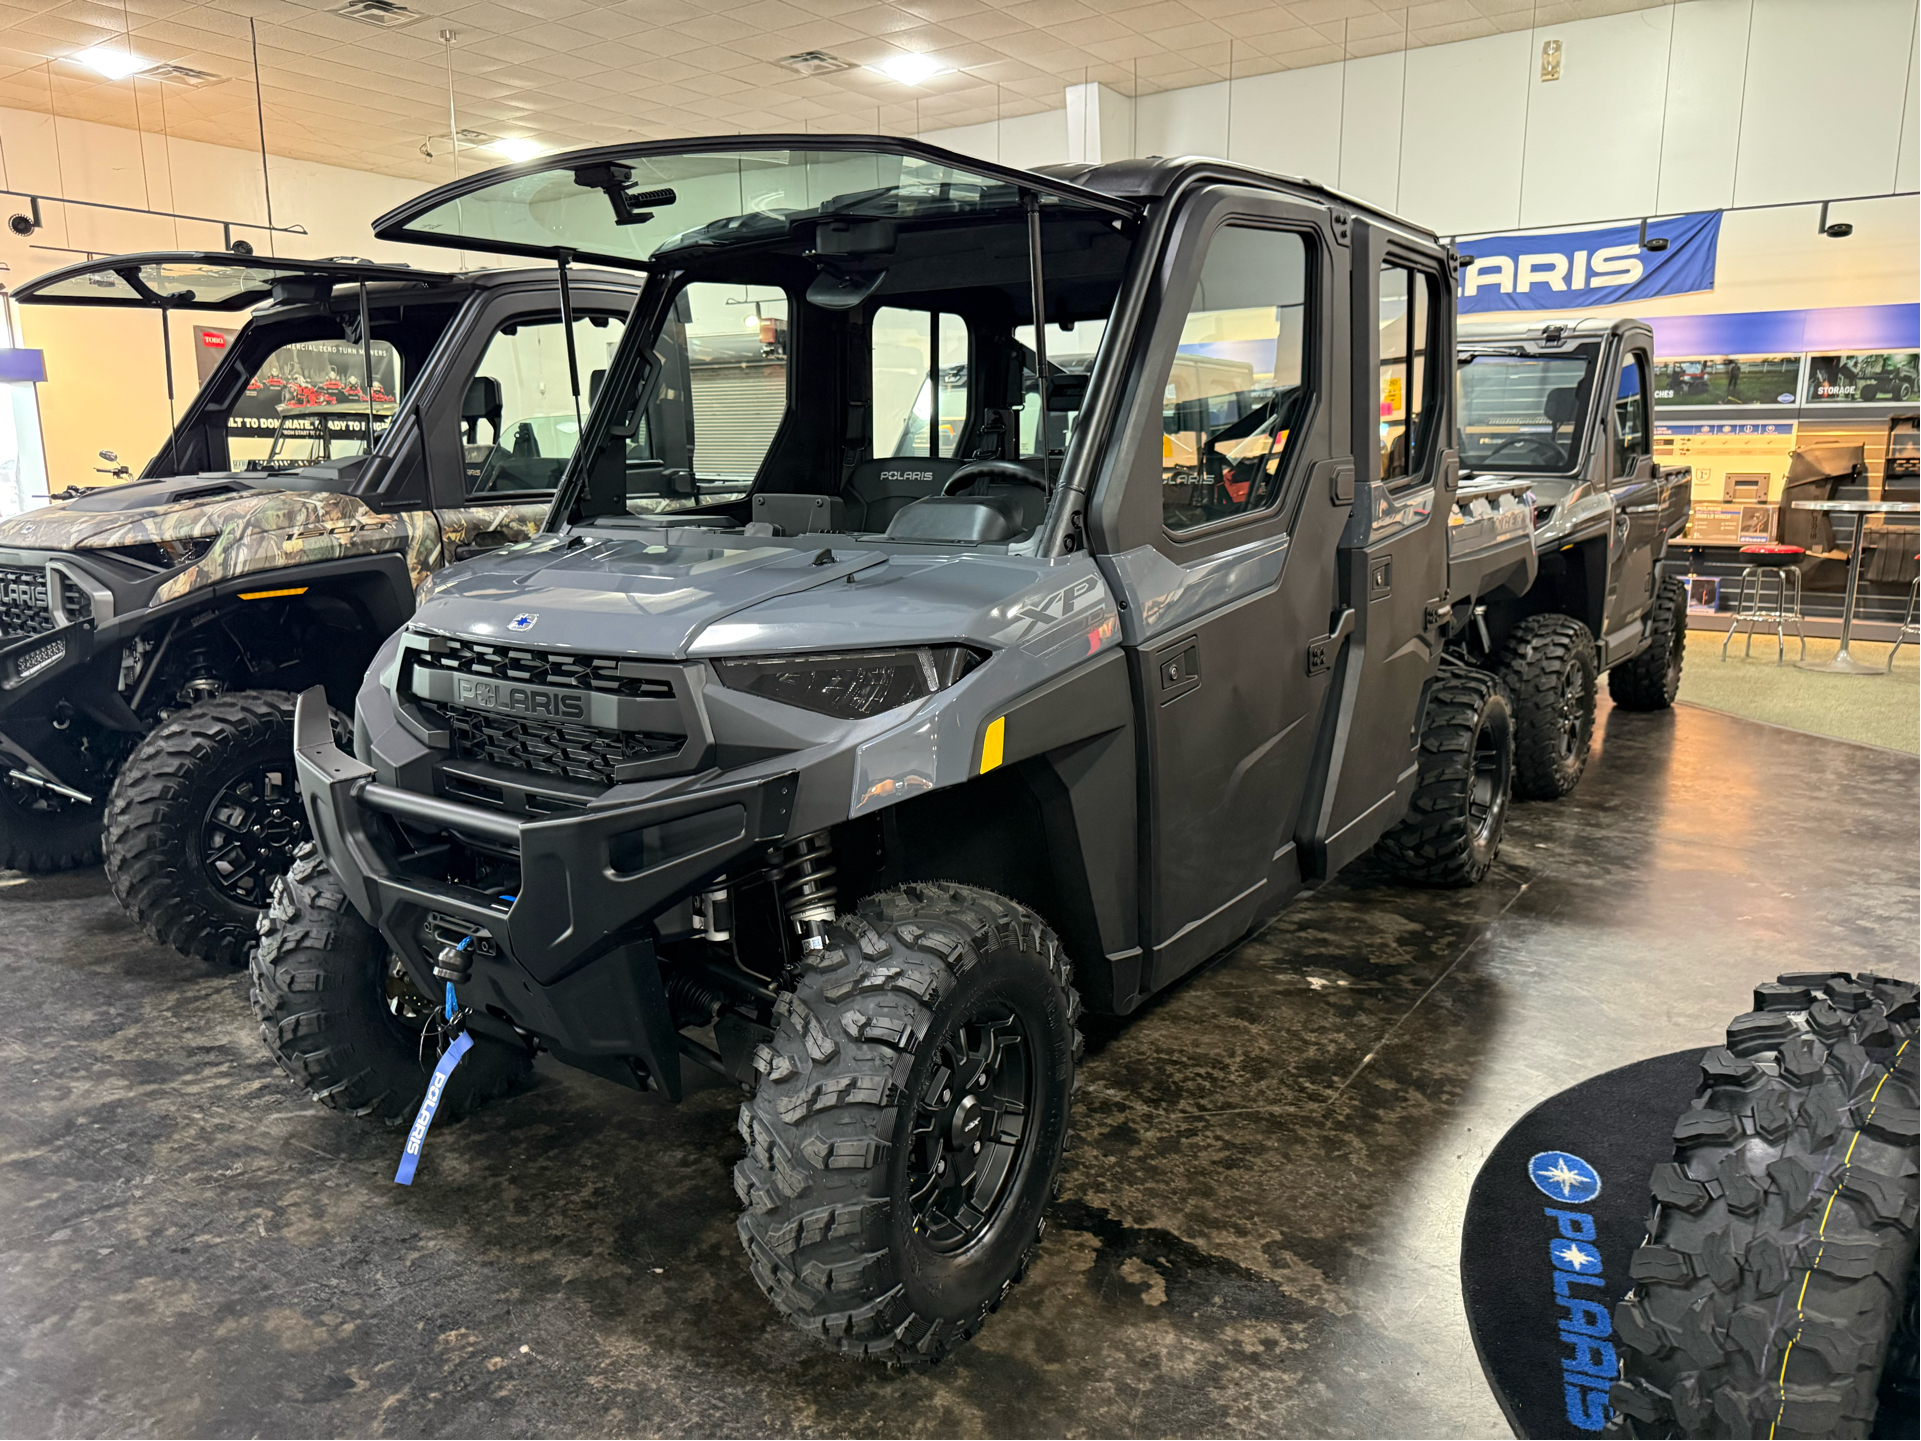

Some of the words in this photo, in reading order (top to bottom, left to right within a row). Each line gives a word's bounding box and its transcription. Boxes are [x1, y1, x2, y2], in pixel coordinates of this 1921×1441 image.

[1458, 244, 1643, 297] ARIS
[319, 346, 337, 354] ZERO
[339, 347, 357, 355] TURN
[1817, 386, 1856, 395] STORAGE
[244, 418, 258, 428] TO
[347, 421, 360, 431] TO
[880, 471, 933, 481] POLARIS
[286, 522, 386, 542] 1500
[1015, 574, 1100, 642] XP
[458, 678, 584, 721] POLARIS
[406, 1071, 447, 1156] POLARIS
[1544, 1207, 1619, 1432] POLARIS
